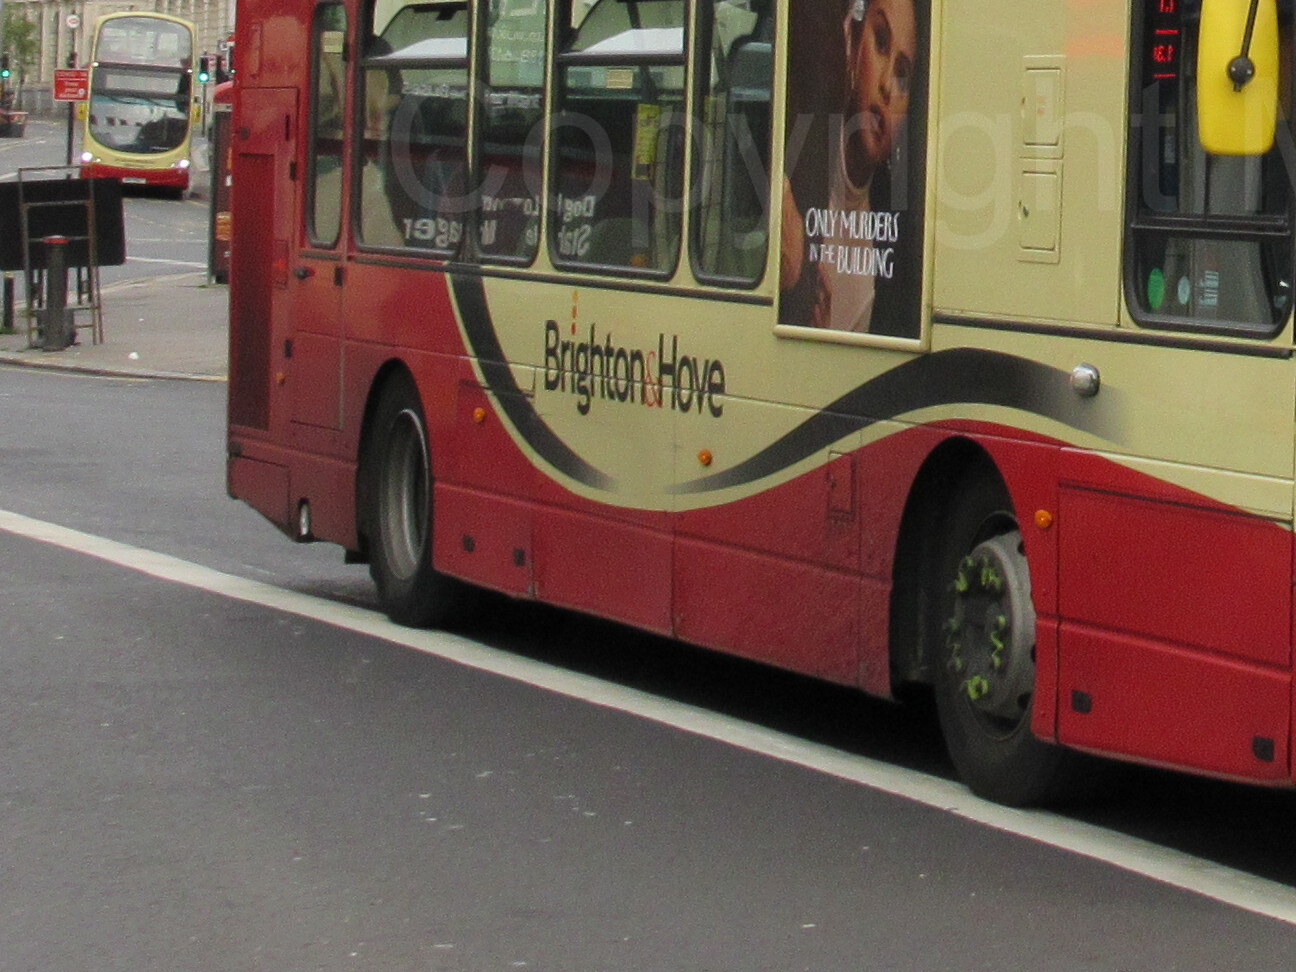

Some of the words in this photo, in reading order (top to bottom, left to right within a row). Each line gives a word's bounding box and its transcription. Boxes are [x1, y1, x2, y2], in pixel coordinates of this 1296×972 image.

[805, 206, 838, 239] ONLY
[840, 210, 900, 243] MURDERS
[837, 245, 895, 279] BUILDING
